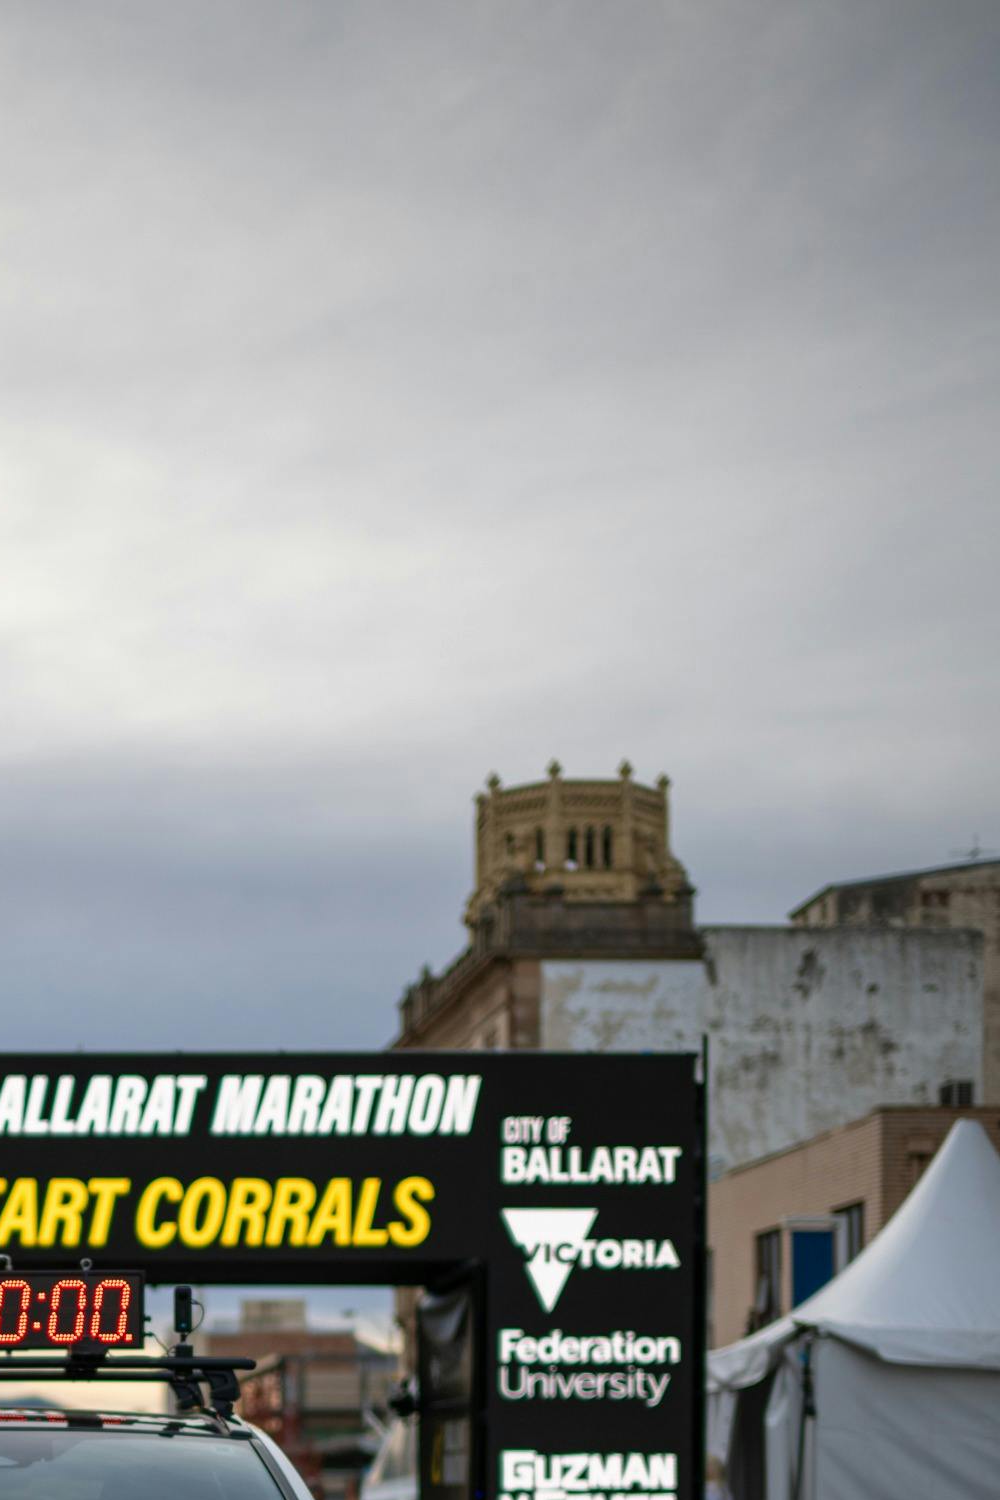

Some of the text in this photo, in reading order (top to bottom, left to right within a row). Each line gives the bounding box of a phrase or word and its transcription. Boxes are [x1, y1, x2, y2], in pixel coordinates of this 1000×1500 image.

[210, 1074, 482, 1136] MARATHON
[502, 1116, 571, 1143] CITY OF
[501, 1145, 682, 1184] BALLARAT
[135, 1176, 436, 1248] CORRALS
[518, 1238, 680, 1268] VICTORIA
[499, 1328, 681, 1364] Federation
[499, 1365, 670, 1407] University
[500, 1449, 678, 1491] GUZMAN
